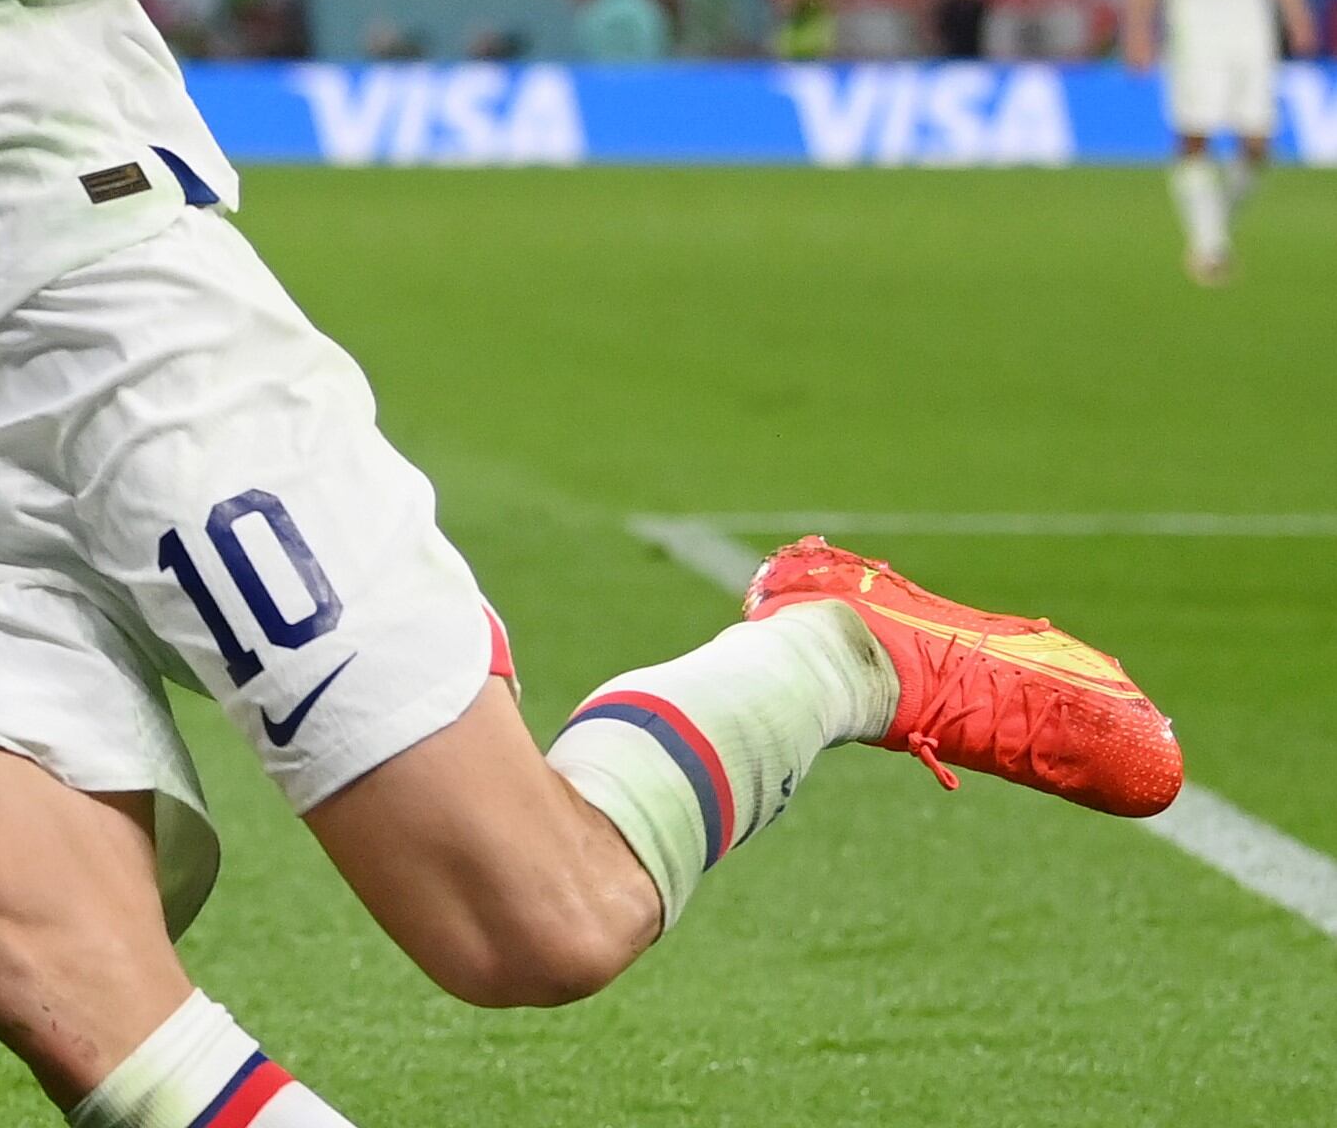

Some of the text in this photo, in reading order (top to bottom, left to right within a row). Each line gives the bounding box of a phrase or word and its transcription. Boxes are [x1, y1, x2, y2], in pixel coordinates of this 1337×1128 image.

[283, 62, 588, 167] VISA
[771, 62, 1078, 168] VISA
[158, 488, 343, 688] 10
